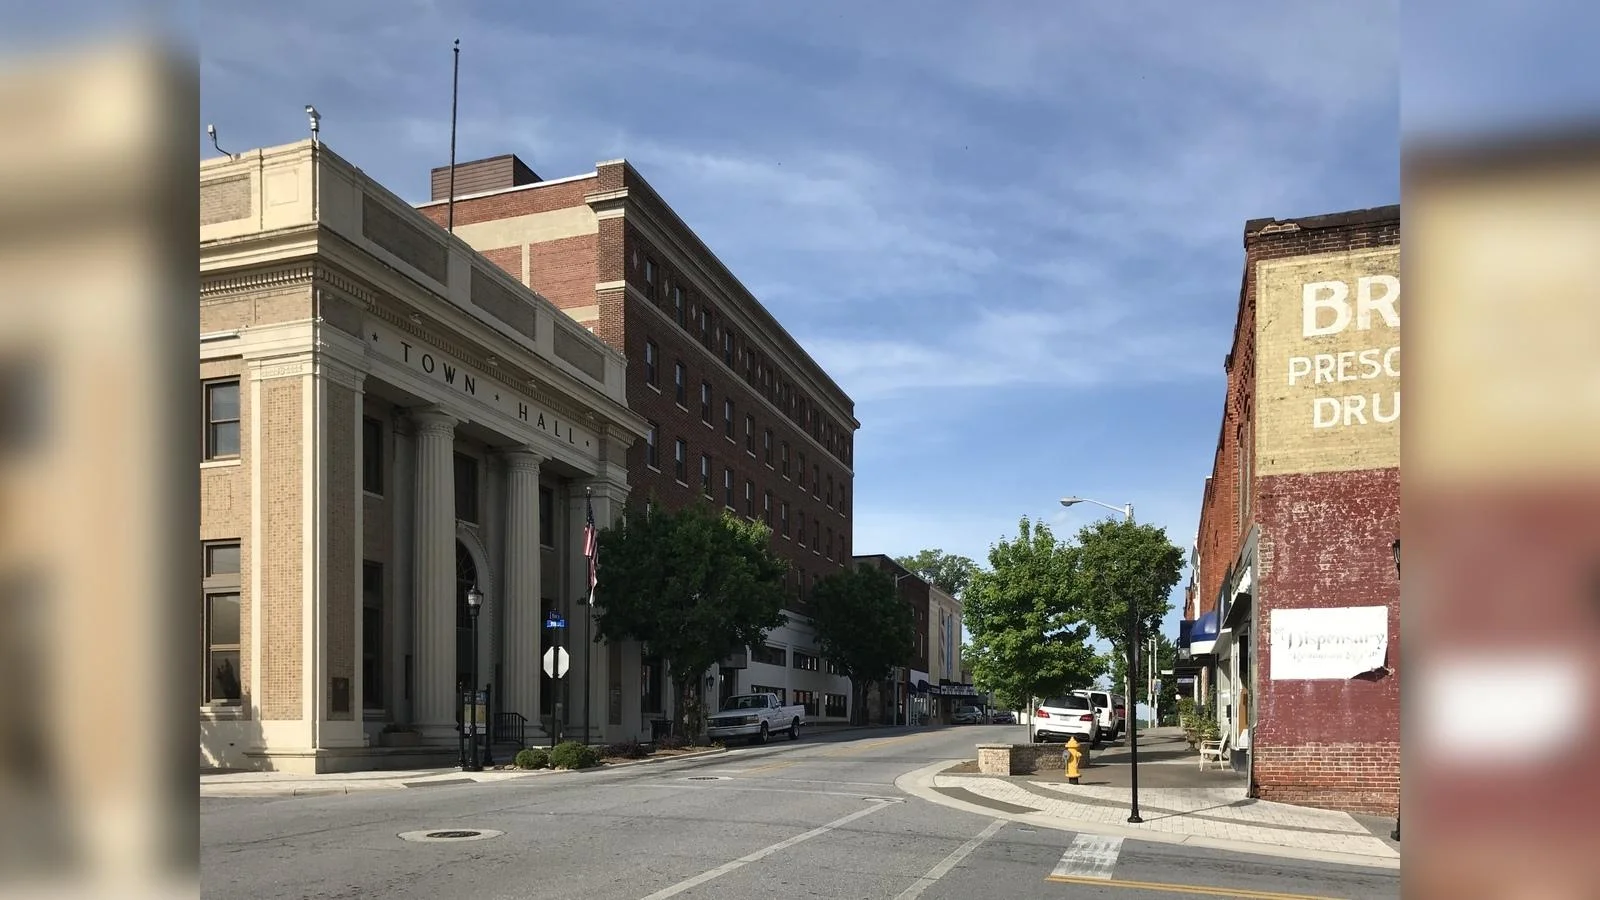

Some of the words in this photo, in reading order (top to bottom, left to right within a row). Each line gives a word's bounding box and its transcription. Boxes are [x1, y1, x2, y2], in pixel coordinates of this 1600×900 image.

[401, 341, 476, 395] TOWN
[519, 402, 575, 444] HALL
[1313, 392, 1400, 428] DRU
[1288, 631, 1385, 651] Dispensary
